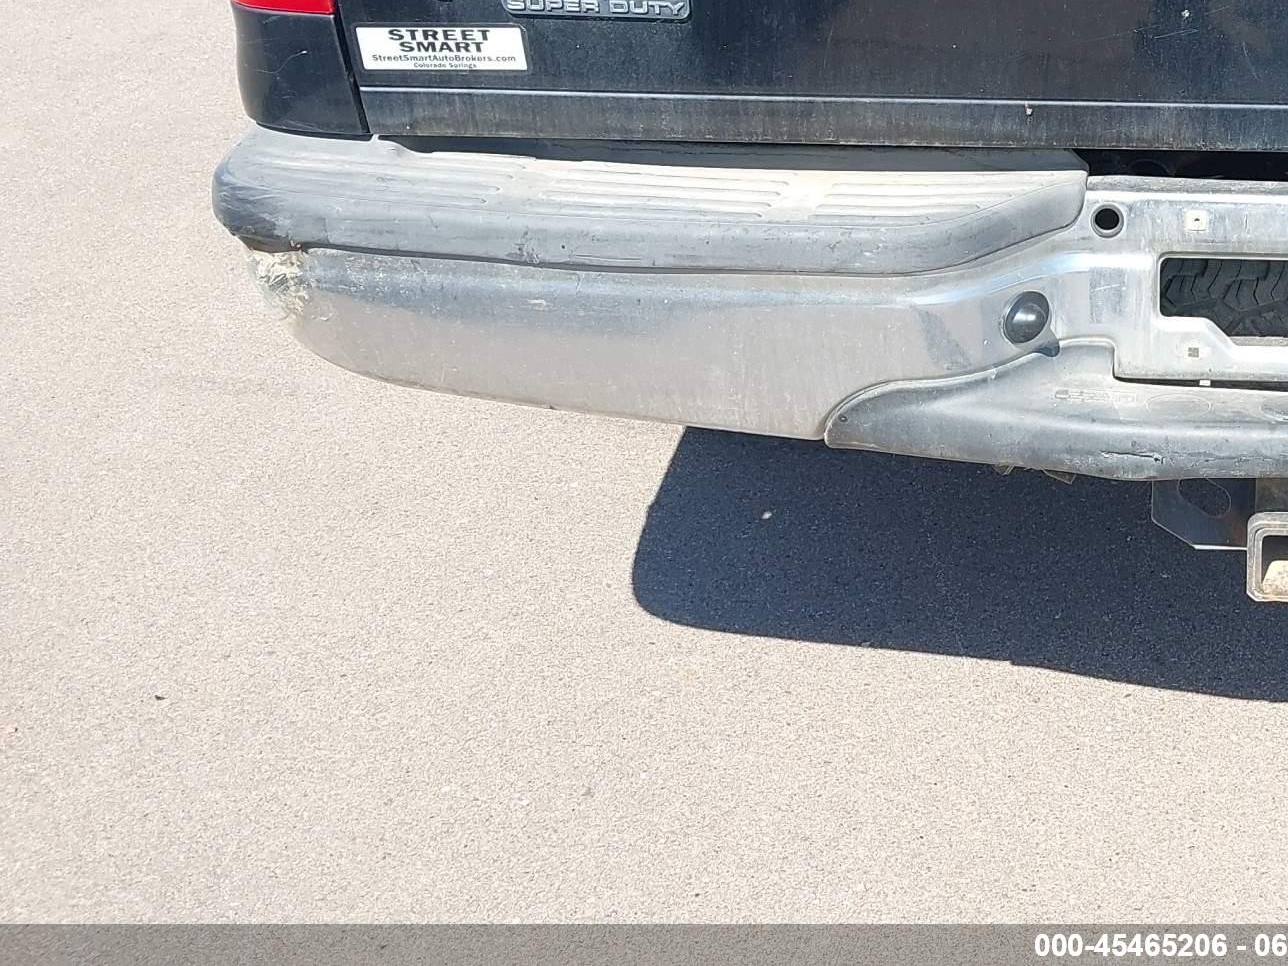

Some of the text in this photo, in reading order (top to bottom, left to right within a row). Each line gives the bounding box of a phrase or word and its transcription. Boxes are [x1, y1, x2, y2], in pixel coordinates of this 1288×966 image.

[609, 0, 686, 16] DUTY
[388, 28, 491, 42] STREET
[399, 41, 485, 53] SMART
[371, 54, 516, 63] StreetSmartAutoBrokers.com
[448, 62, 477, 70] Springs
